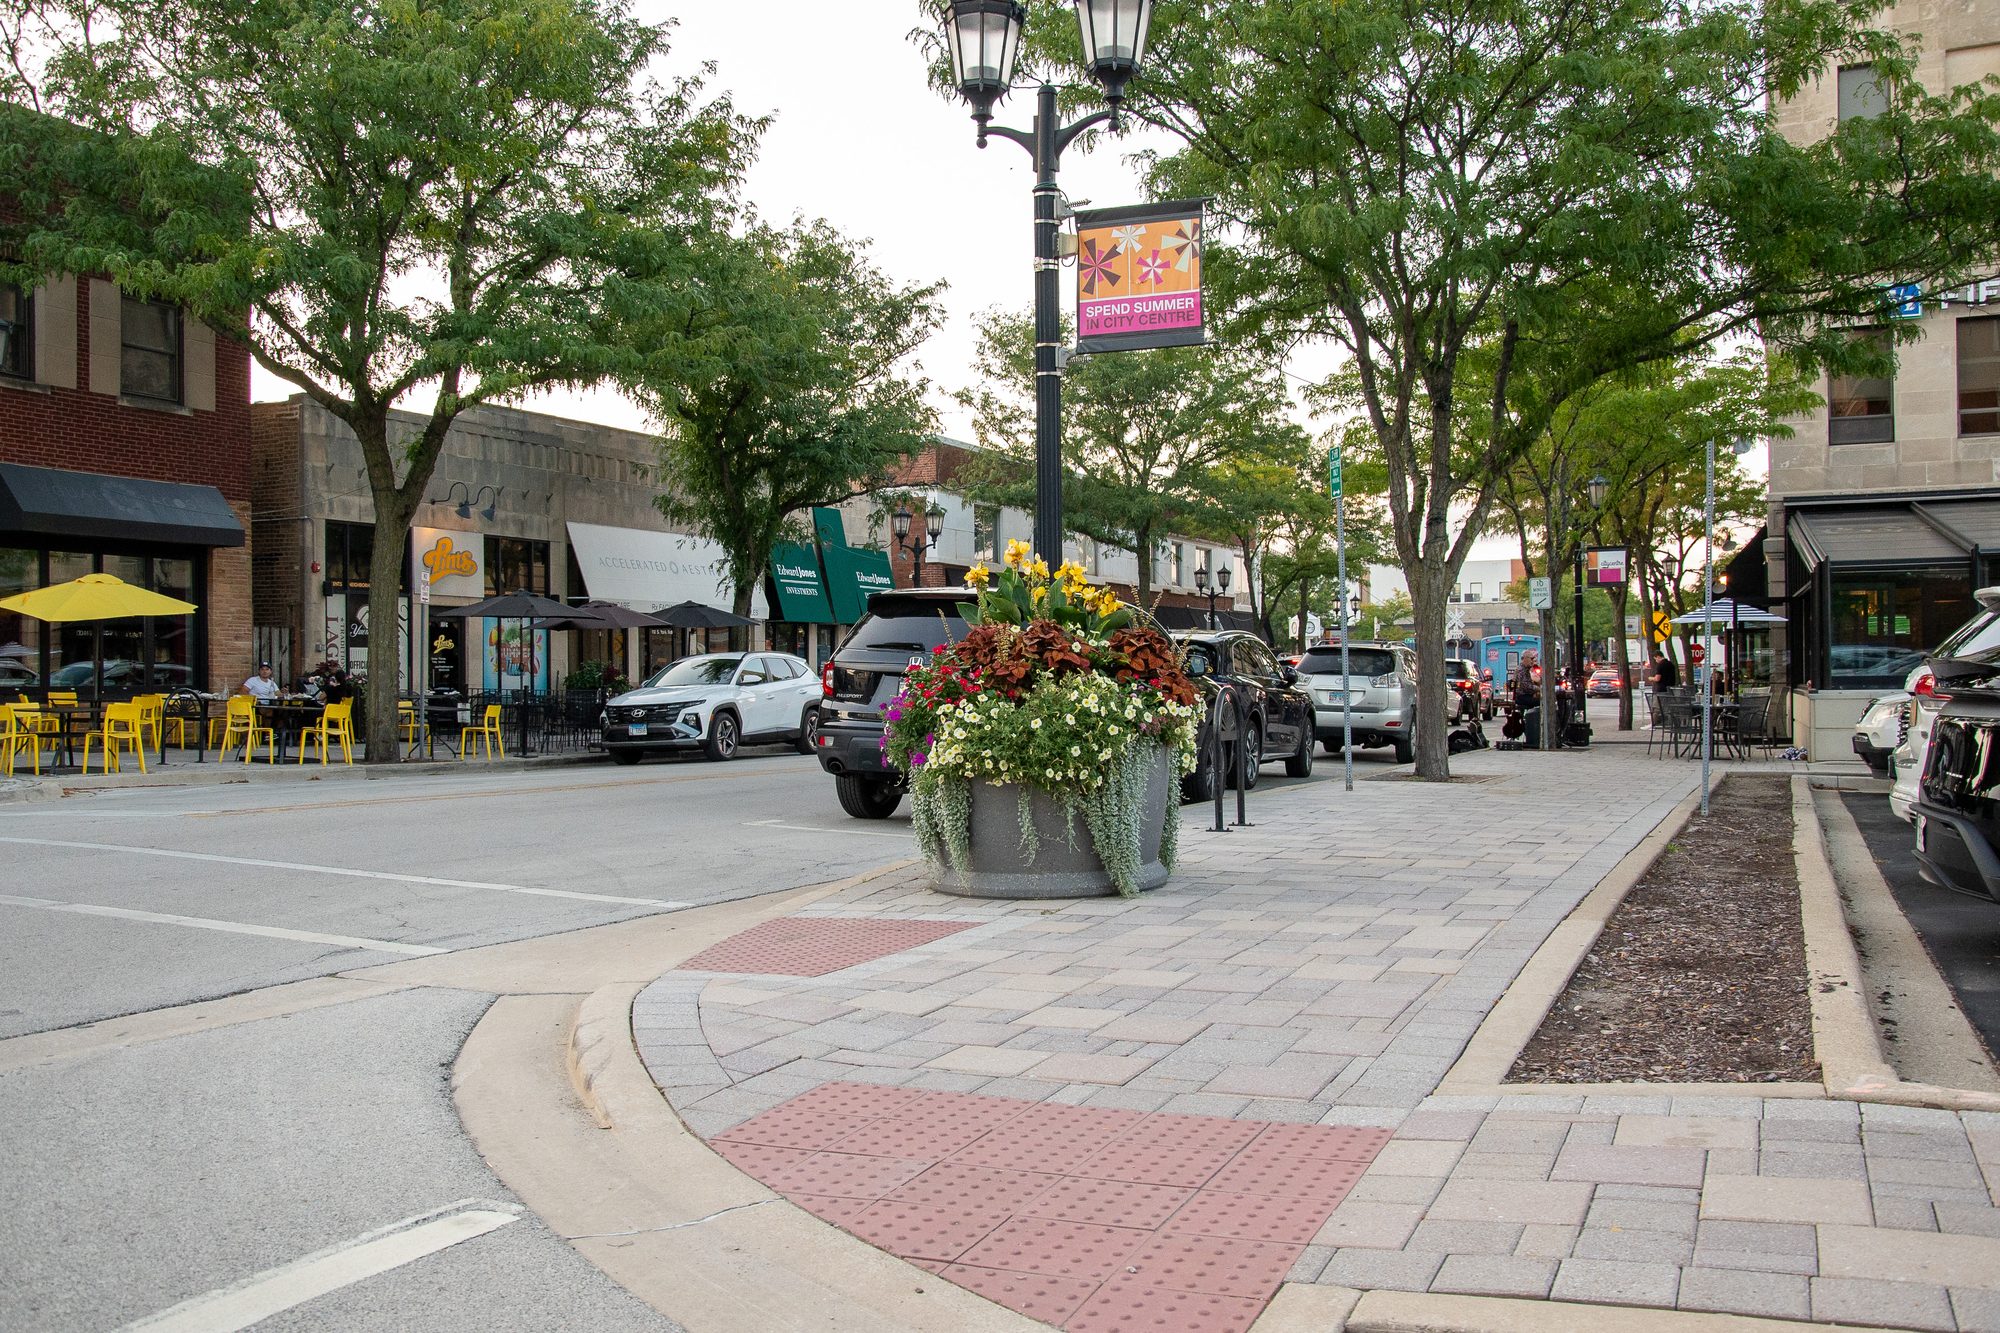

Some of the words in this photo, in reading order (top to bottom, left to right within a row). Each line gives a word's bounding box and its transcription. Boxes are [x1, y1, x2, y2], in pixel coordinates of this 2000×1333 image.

[1085, 303, 1131, 318] SPEND
[1133, 297, 1195, 313] SUMMER
[1086, 318, 1099, 330] IN
[1103, 315, 1135, 329] CITY
[1138, 309, 1196, 326] CENTRE
[599, 557, 668, 573] ACCELERATED
[785, 586, 818, 596] INVESTMENTS
[1663, 623, 1669, 631] R
[1691, 649, 1705, 658] TOP
